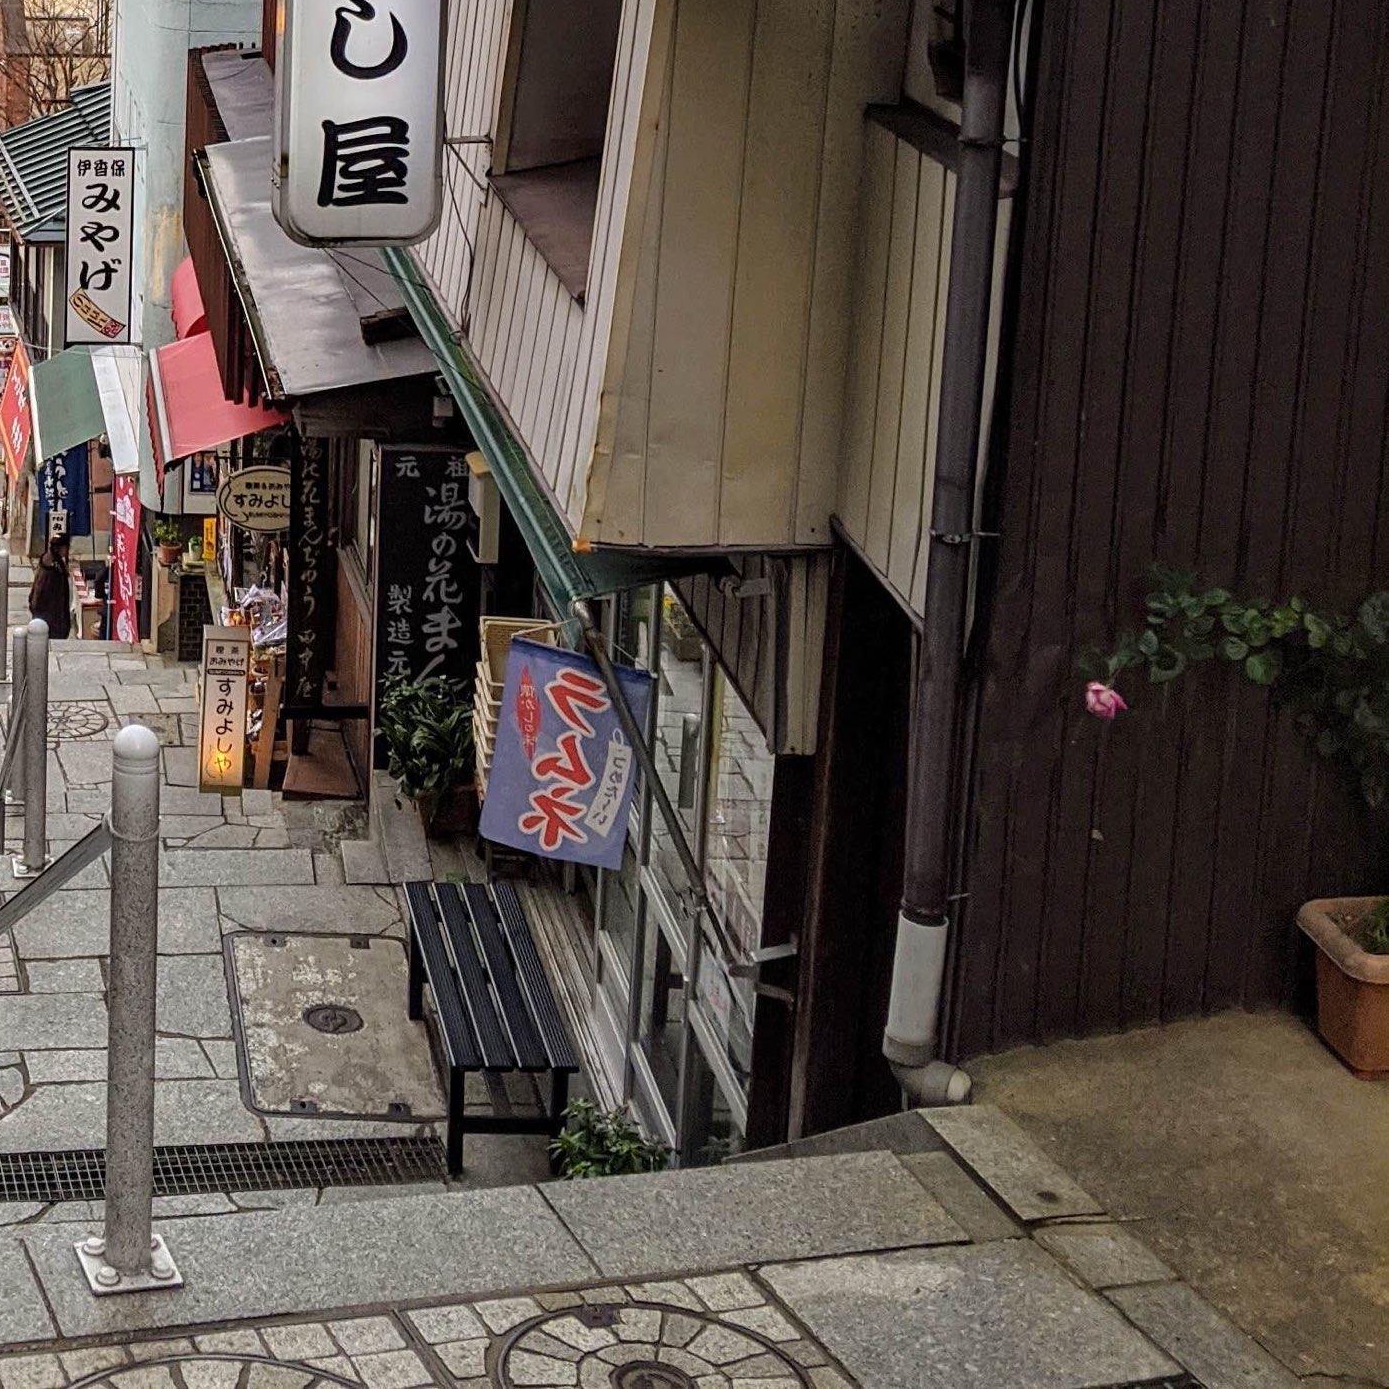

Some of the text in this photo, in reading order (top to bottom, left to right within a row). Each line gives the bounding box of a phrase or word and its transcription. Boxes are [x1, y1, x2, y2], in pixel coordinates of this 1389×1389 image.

[77, 159, 125, 177] 伊香保
[80, 183, 122, 291] みやげ
[396, 456, 470, 478] 元祖
[387, 583, 414, 676] 製造元
[209, 657, 245, 666] おみやげ
[214, 678, 236, 781] すみよしや
